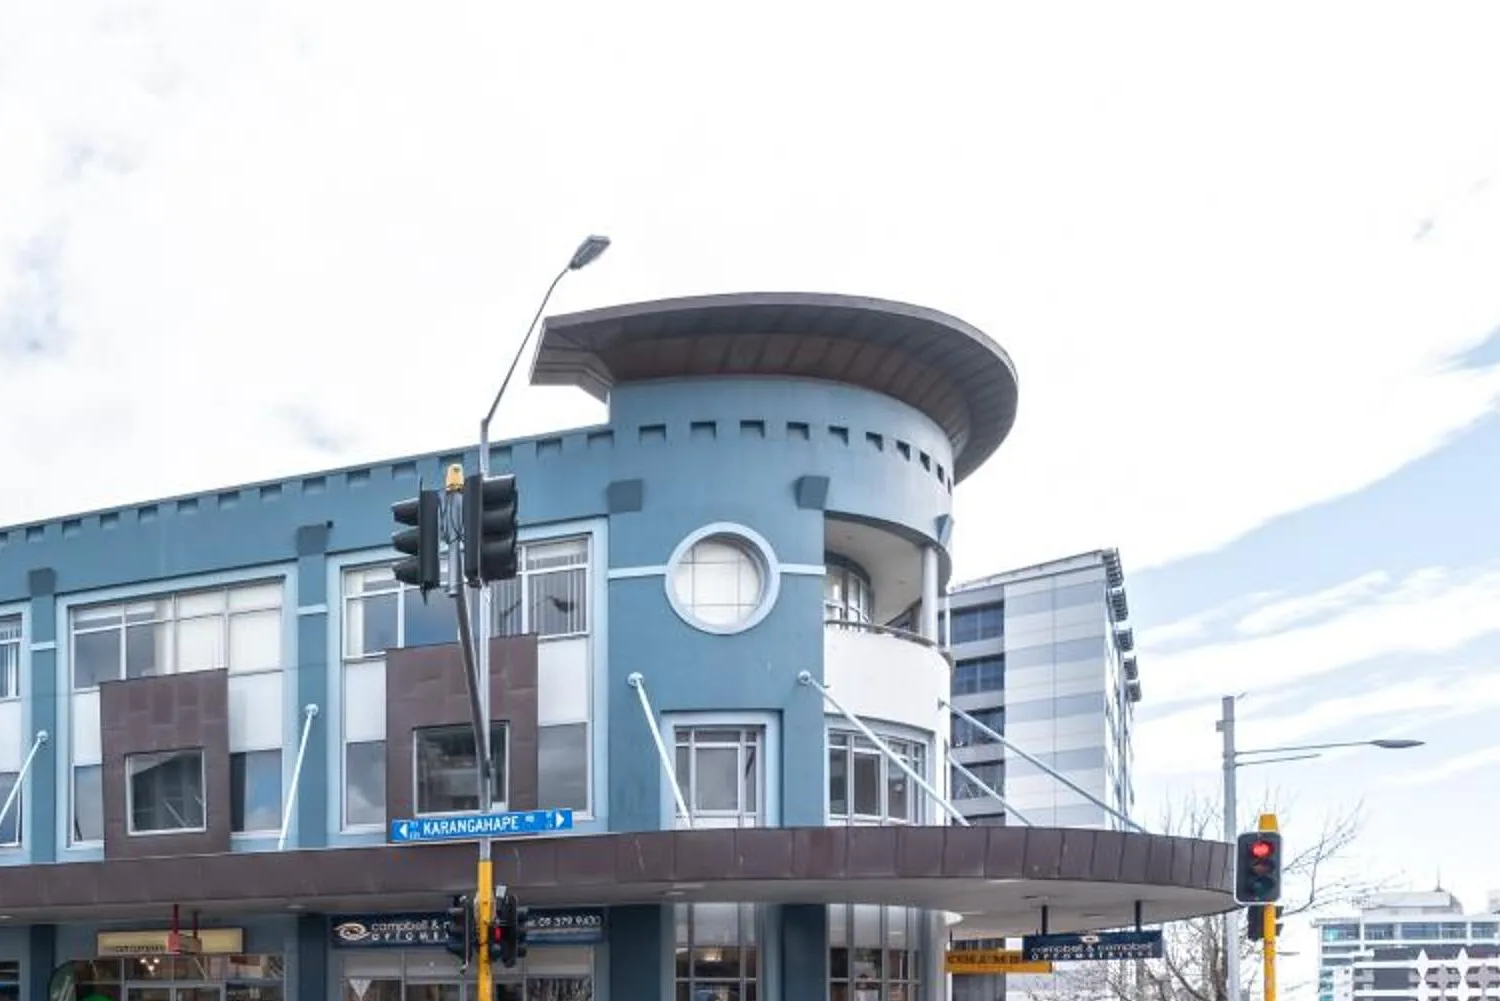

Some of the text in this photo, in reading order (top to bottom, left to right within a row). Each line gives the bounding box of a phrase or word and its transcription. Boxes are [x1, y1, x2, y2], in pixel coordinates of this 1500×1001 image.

[423, 815, 519, 835] KARANGAHAPE
[371, 920, 428, 933] campbell
[431, 919, 440, 930] &
